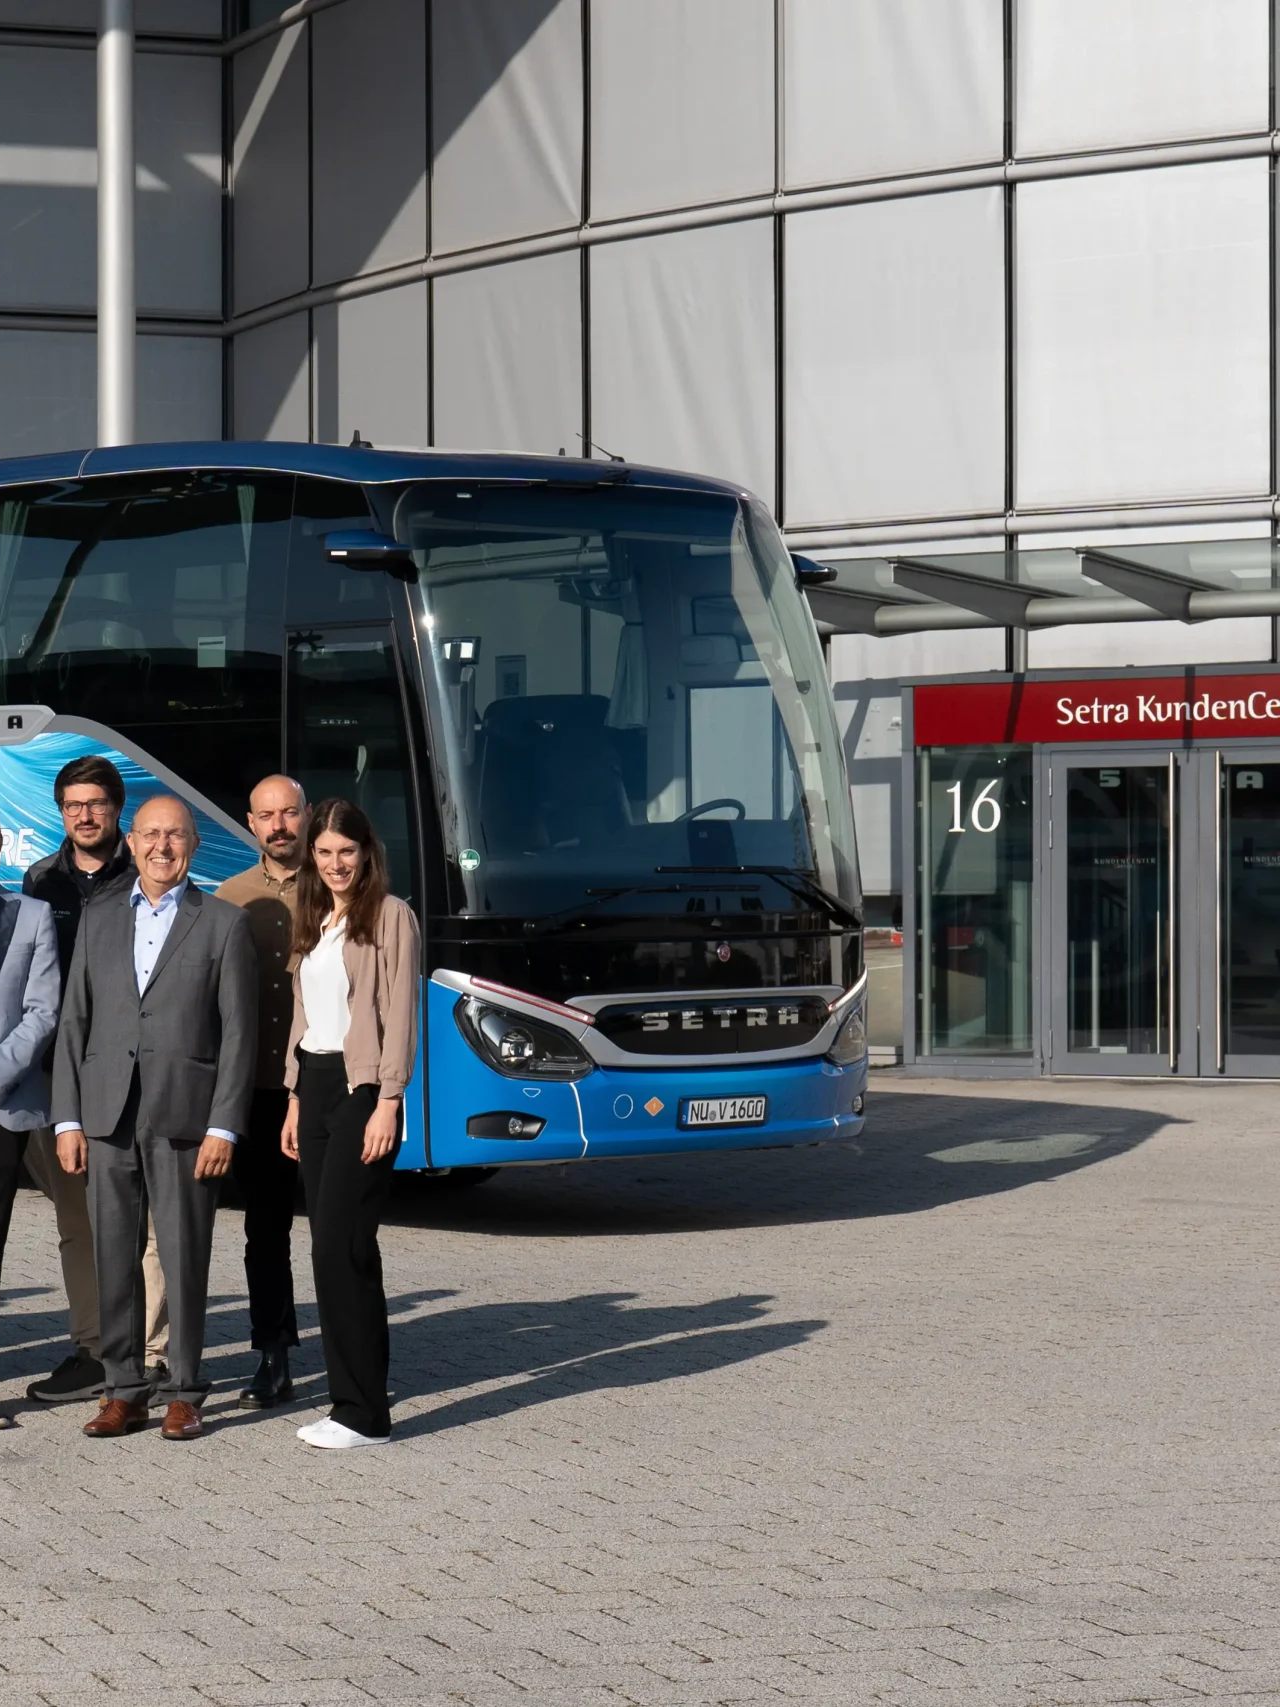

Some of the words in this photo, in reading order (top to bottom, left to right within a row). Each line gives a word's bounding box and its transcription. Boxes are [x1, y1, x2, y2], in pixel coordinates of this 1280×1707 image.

[1056, 697, 1129, 725] Setra
[1136, 691, 1280, 722] KundenCe
[946, 779, 1001, 832] 16
[641, 1006, 799, 1031] SETRA
[690, 1102, 710, 1121] NU
[719, 1101, 727, 1120] V
[729, 1100, 763, 1119] 1600
